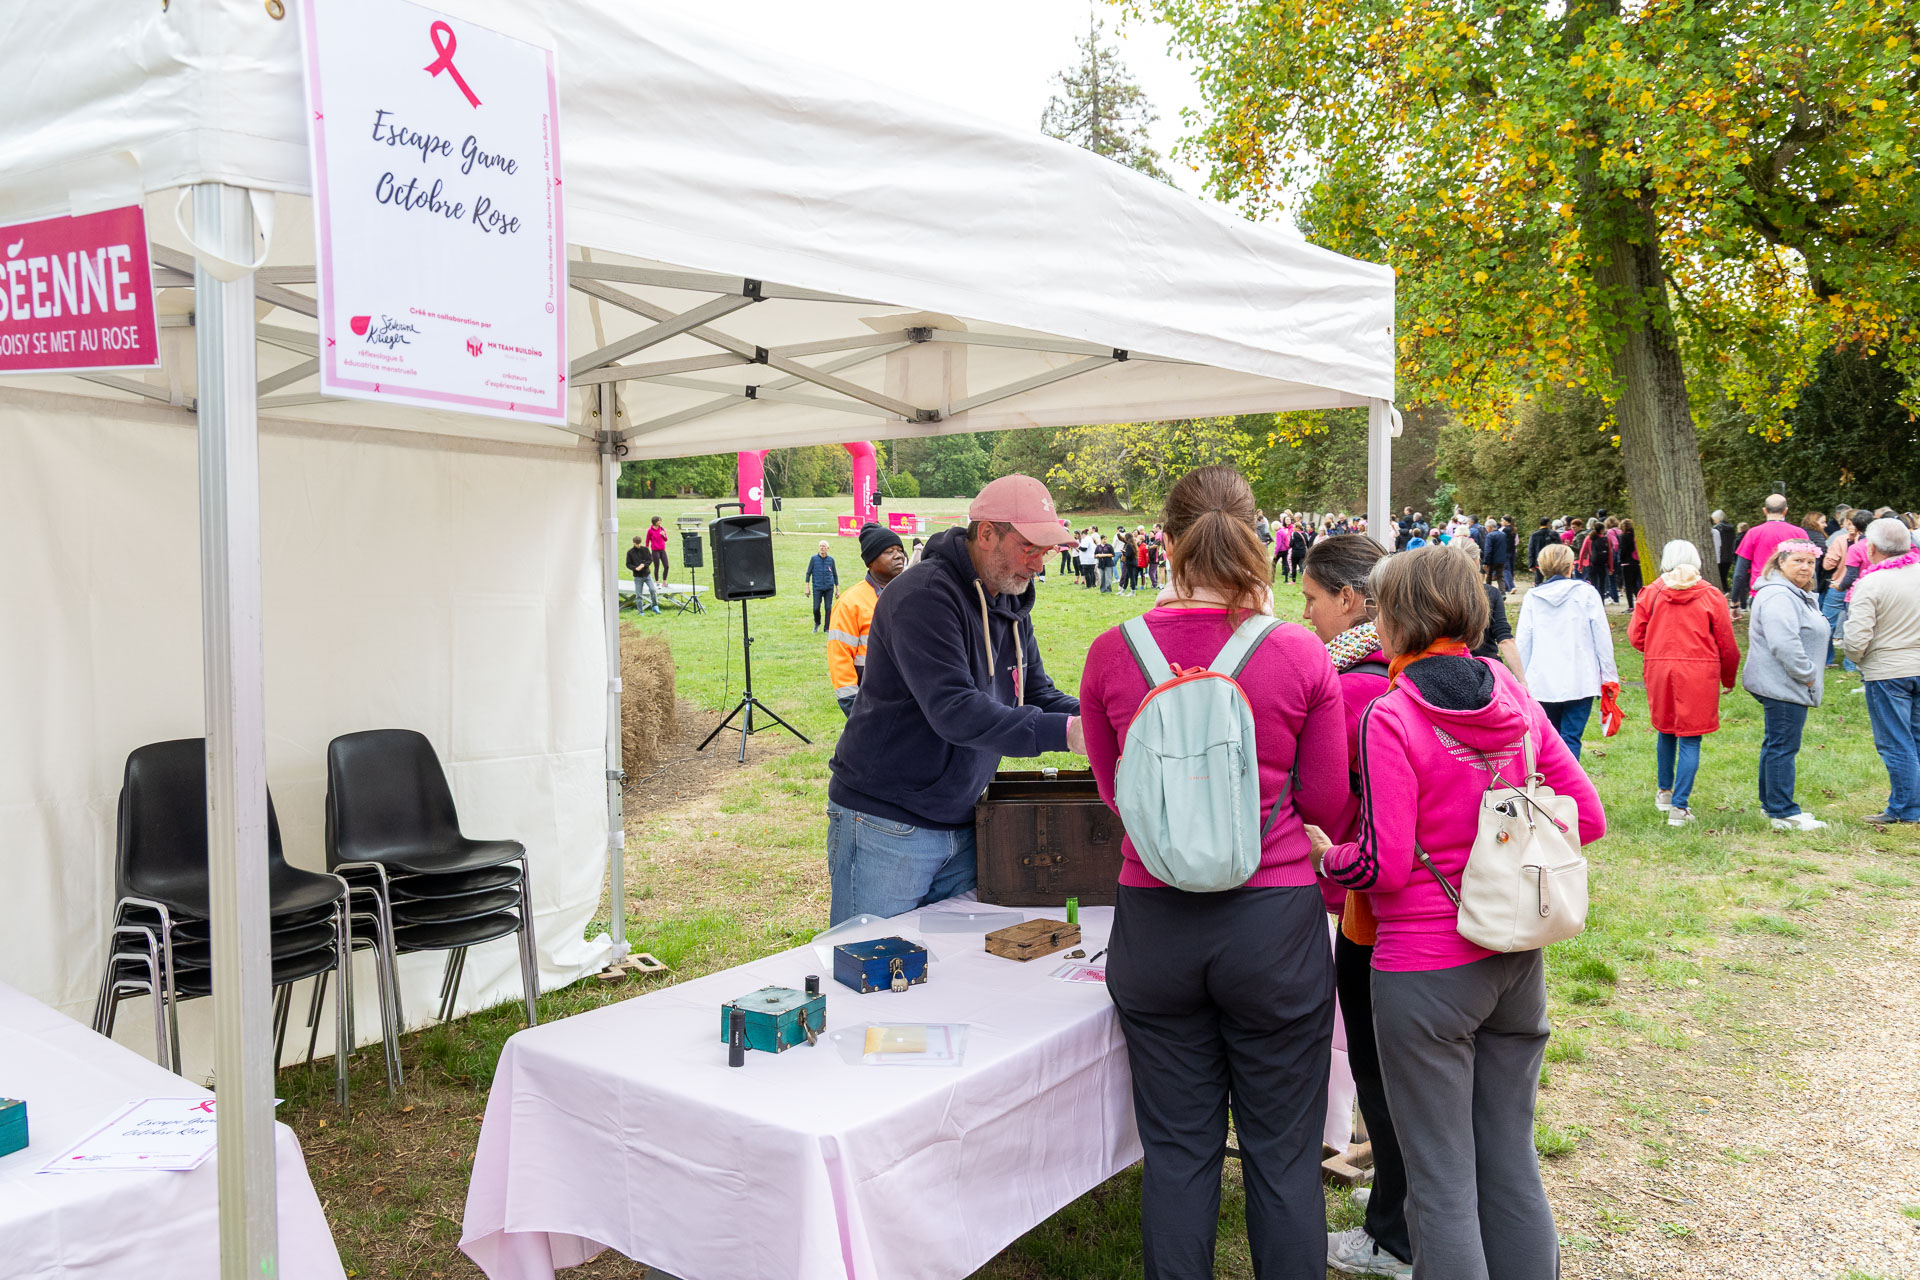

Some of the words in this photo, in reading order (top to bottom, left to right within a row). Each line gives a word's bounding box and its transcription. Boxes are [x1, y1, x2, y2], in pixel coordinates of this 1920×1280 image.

[372, 109, 454, 163] Escape
[461, 135, 519, 175] Game
[376, 172, 466, 219] Octobre
[472, 196, 521, 235] Rose
[379, 314, 421, 334] Séverine
[409, 307, 426, 316] Créé
[437, 313, 480, 326] collaboration
[32, 332, 48, 354] SE
[50, 330, 76, 353] MET
[80, 328, 98, 351] AU
[101, 326, 140, 350] ROSE
[366, 325, 411, 349] Krieger
[498, 344, 514, 352] TEAM
[344, 358, 380, 370] éducatrice
[381, 365, 417, 375] menstruelle
[523, 386, 545, 394] ludiques
